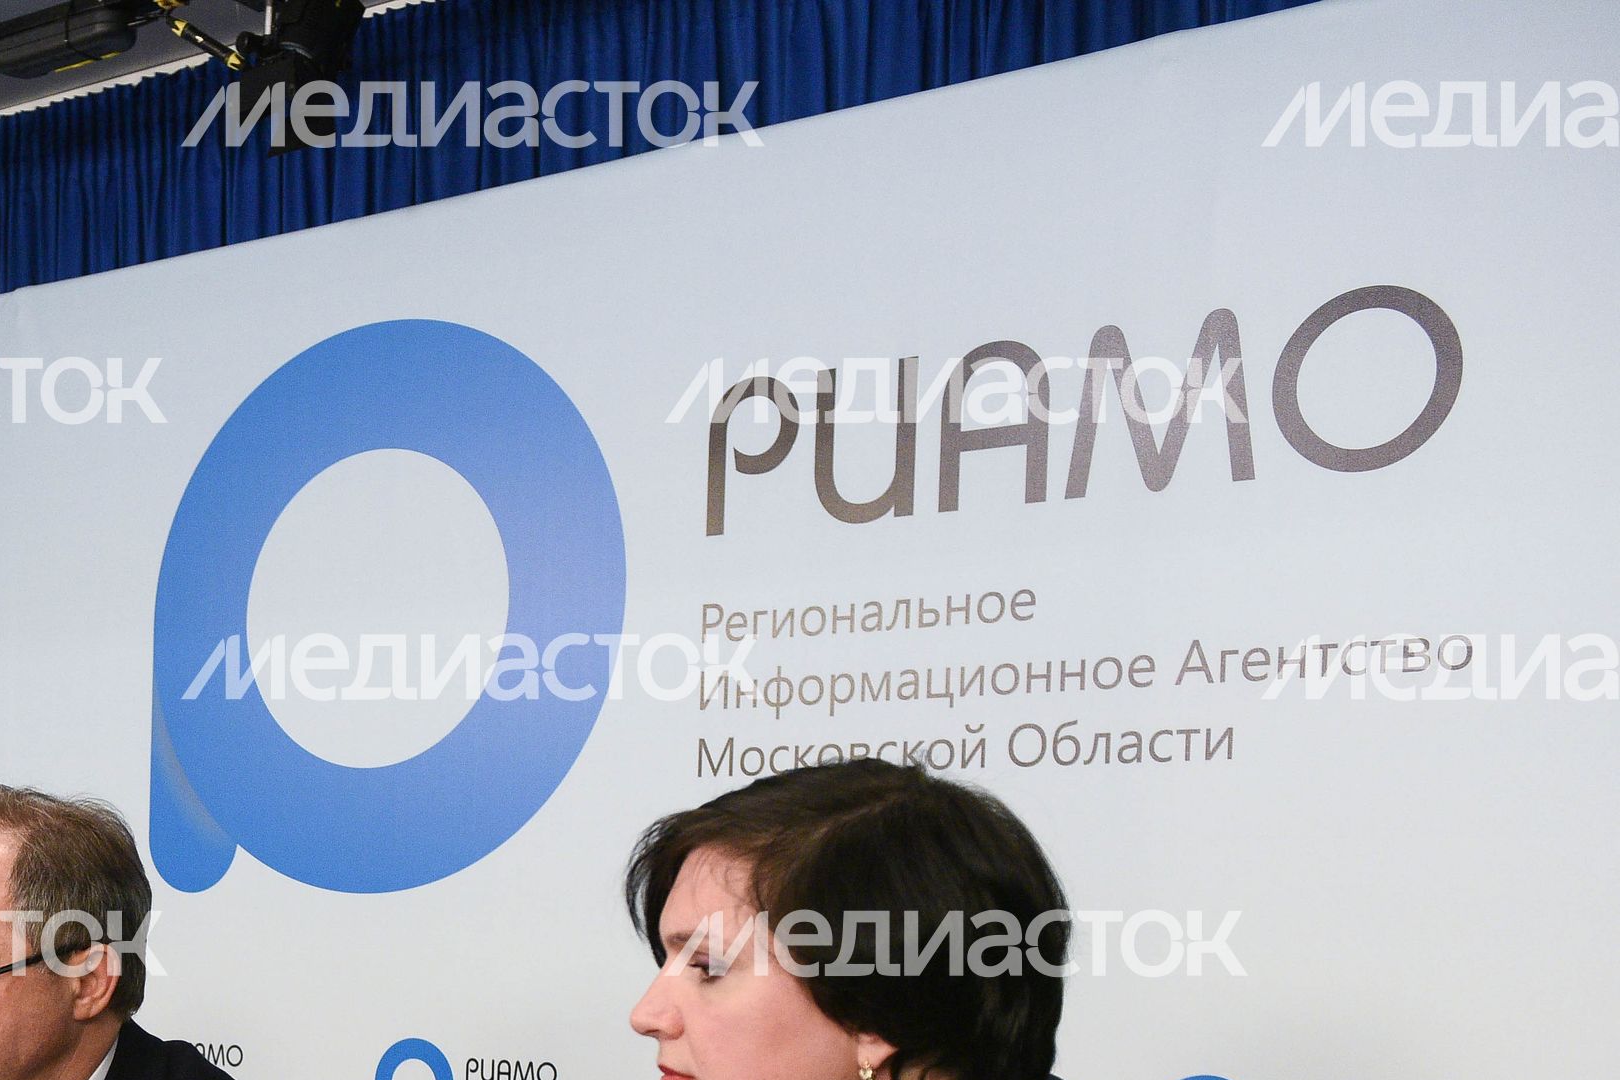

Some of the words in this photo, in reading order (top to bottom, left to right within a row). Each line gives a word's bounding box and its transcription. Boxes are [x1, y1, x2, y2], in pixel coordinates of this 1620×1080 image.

[706, 285, 1463, 537] РИАМО
[701, 588, 1037, 644] Региональное
[699, 653, 1156, 719] Информационное
[1175, 634, 1473, 686] Агентство
[1008, 719, 1234, 768] Области
